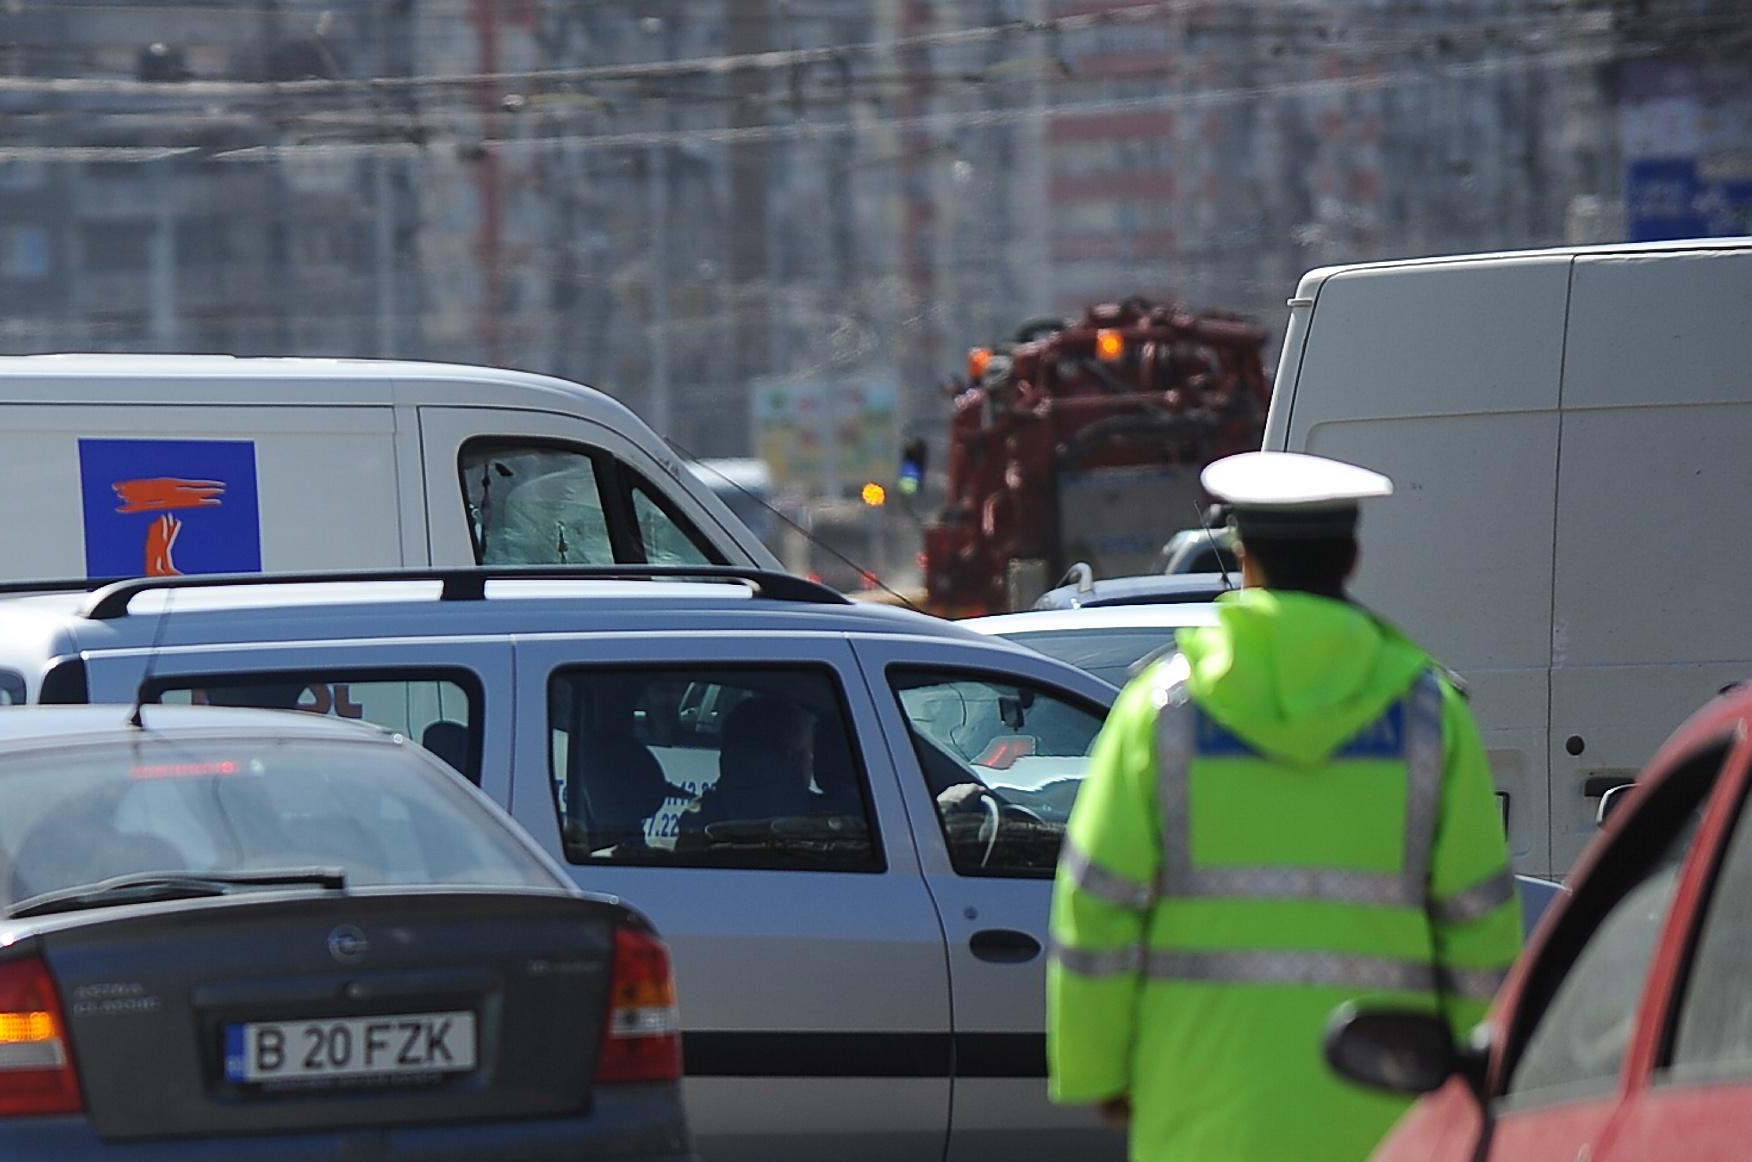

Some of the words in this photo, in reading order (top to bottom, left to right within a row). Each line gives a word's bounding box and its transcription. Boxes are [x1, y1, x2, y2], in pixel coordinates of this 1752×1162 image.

[256, 1027, 286, 1072] B
[303, 1026, 352, 1069] 20
[364, 1019, 454, 1066] FZK
